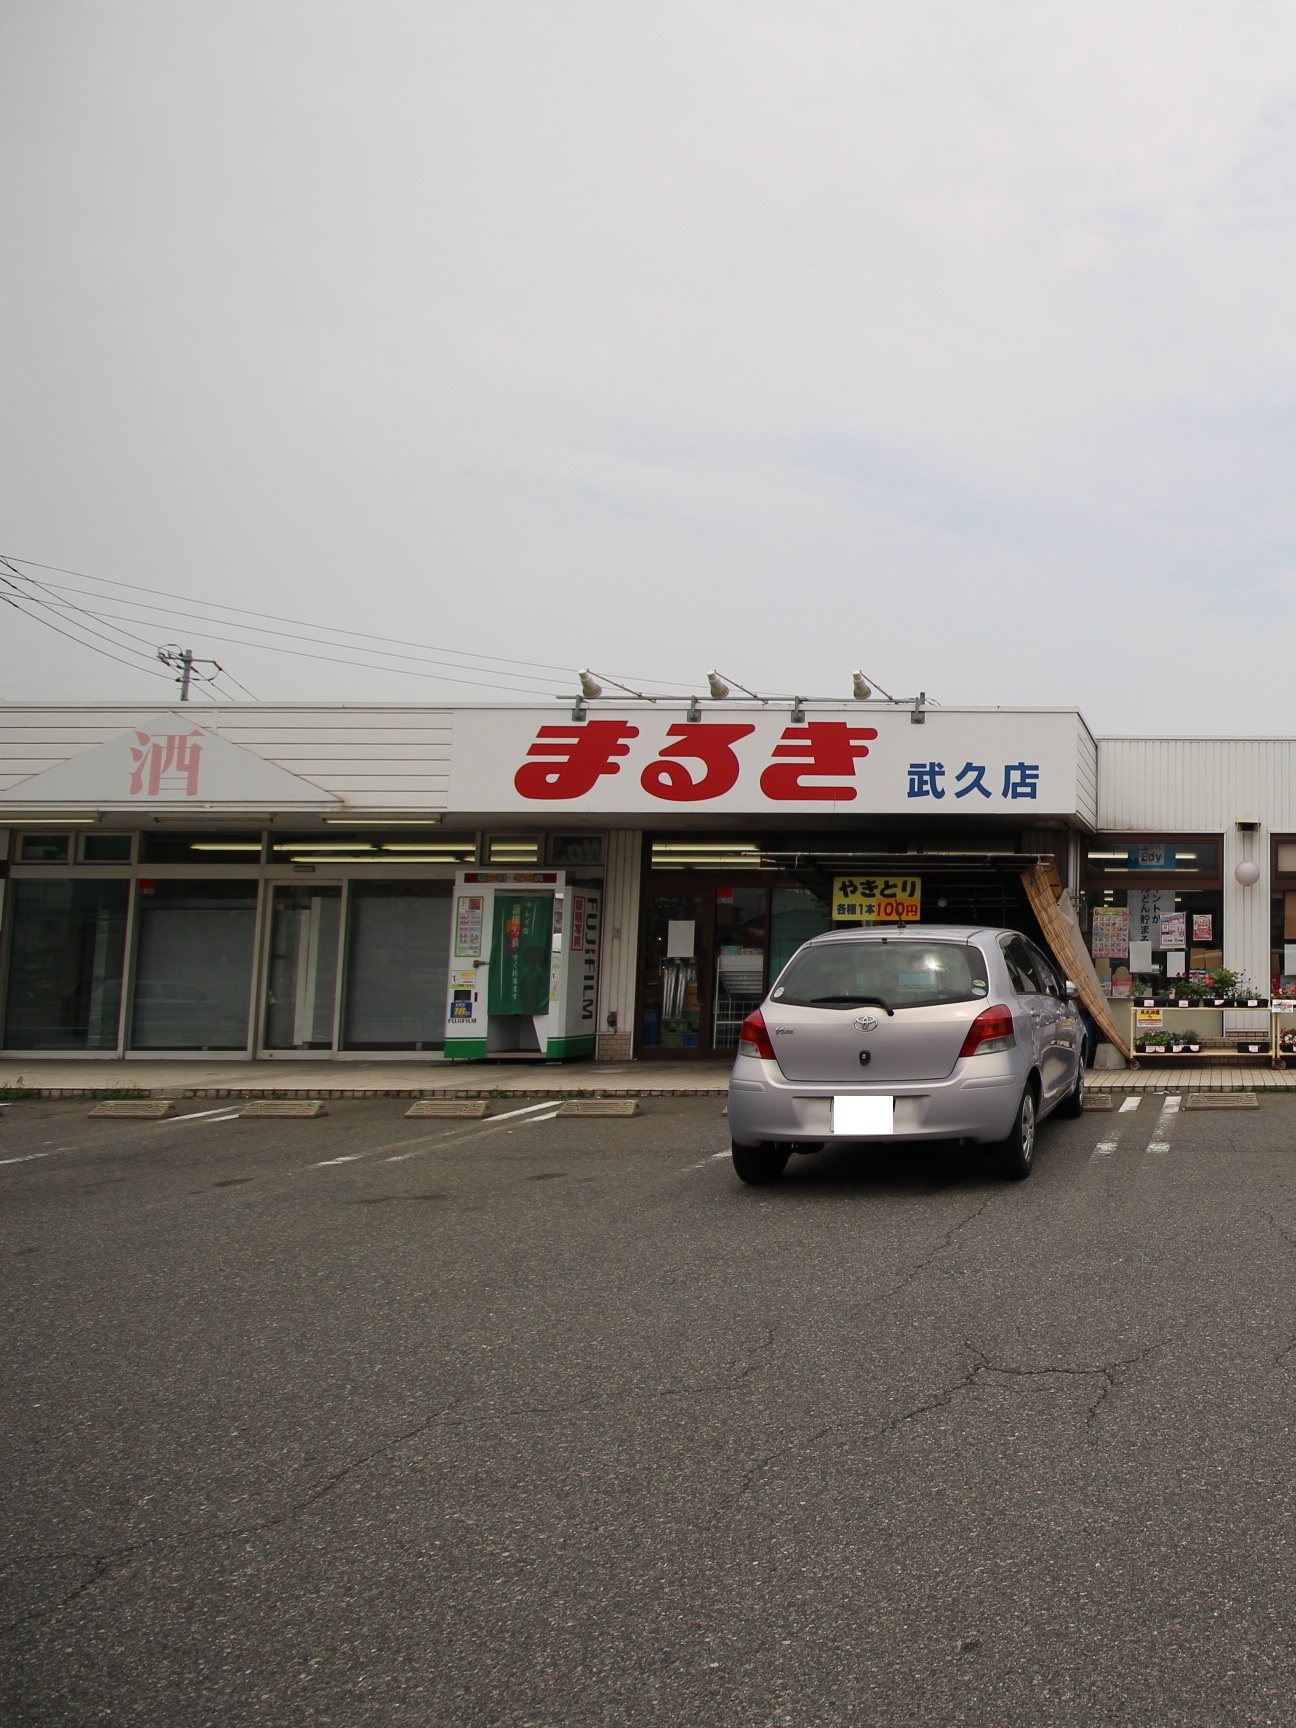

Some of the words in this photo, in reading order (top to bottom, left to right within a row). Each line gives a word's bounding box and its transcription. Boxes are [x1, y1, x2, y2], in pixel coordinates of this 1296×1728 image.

[126, 729, 206, 797] 酒
[514, 720, 878, 802] まるき
[907, 762, 1040, 800] 武久店
[1141, 851, 1162, 864] Edy
[839, 879, 916, 898] やきとり
[1152, 890, 1161, 924] ントが
[581, 897, 599, 1020] FUJIFILM
